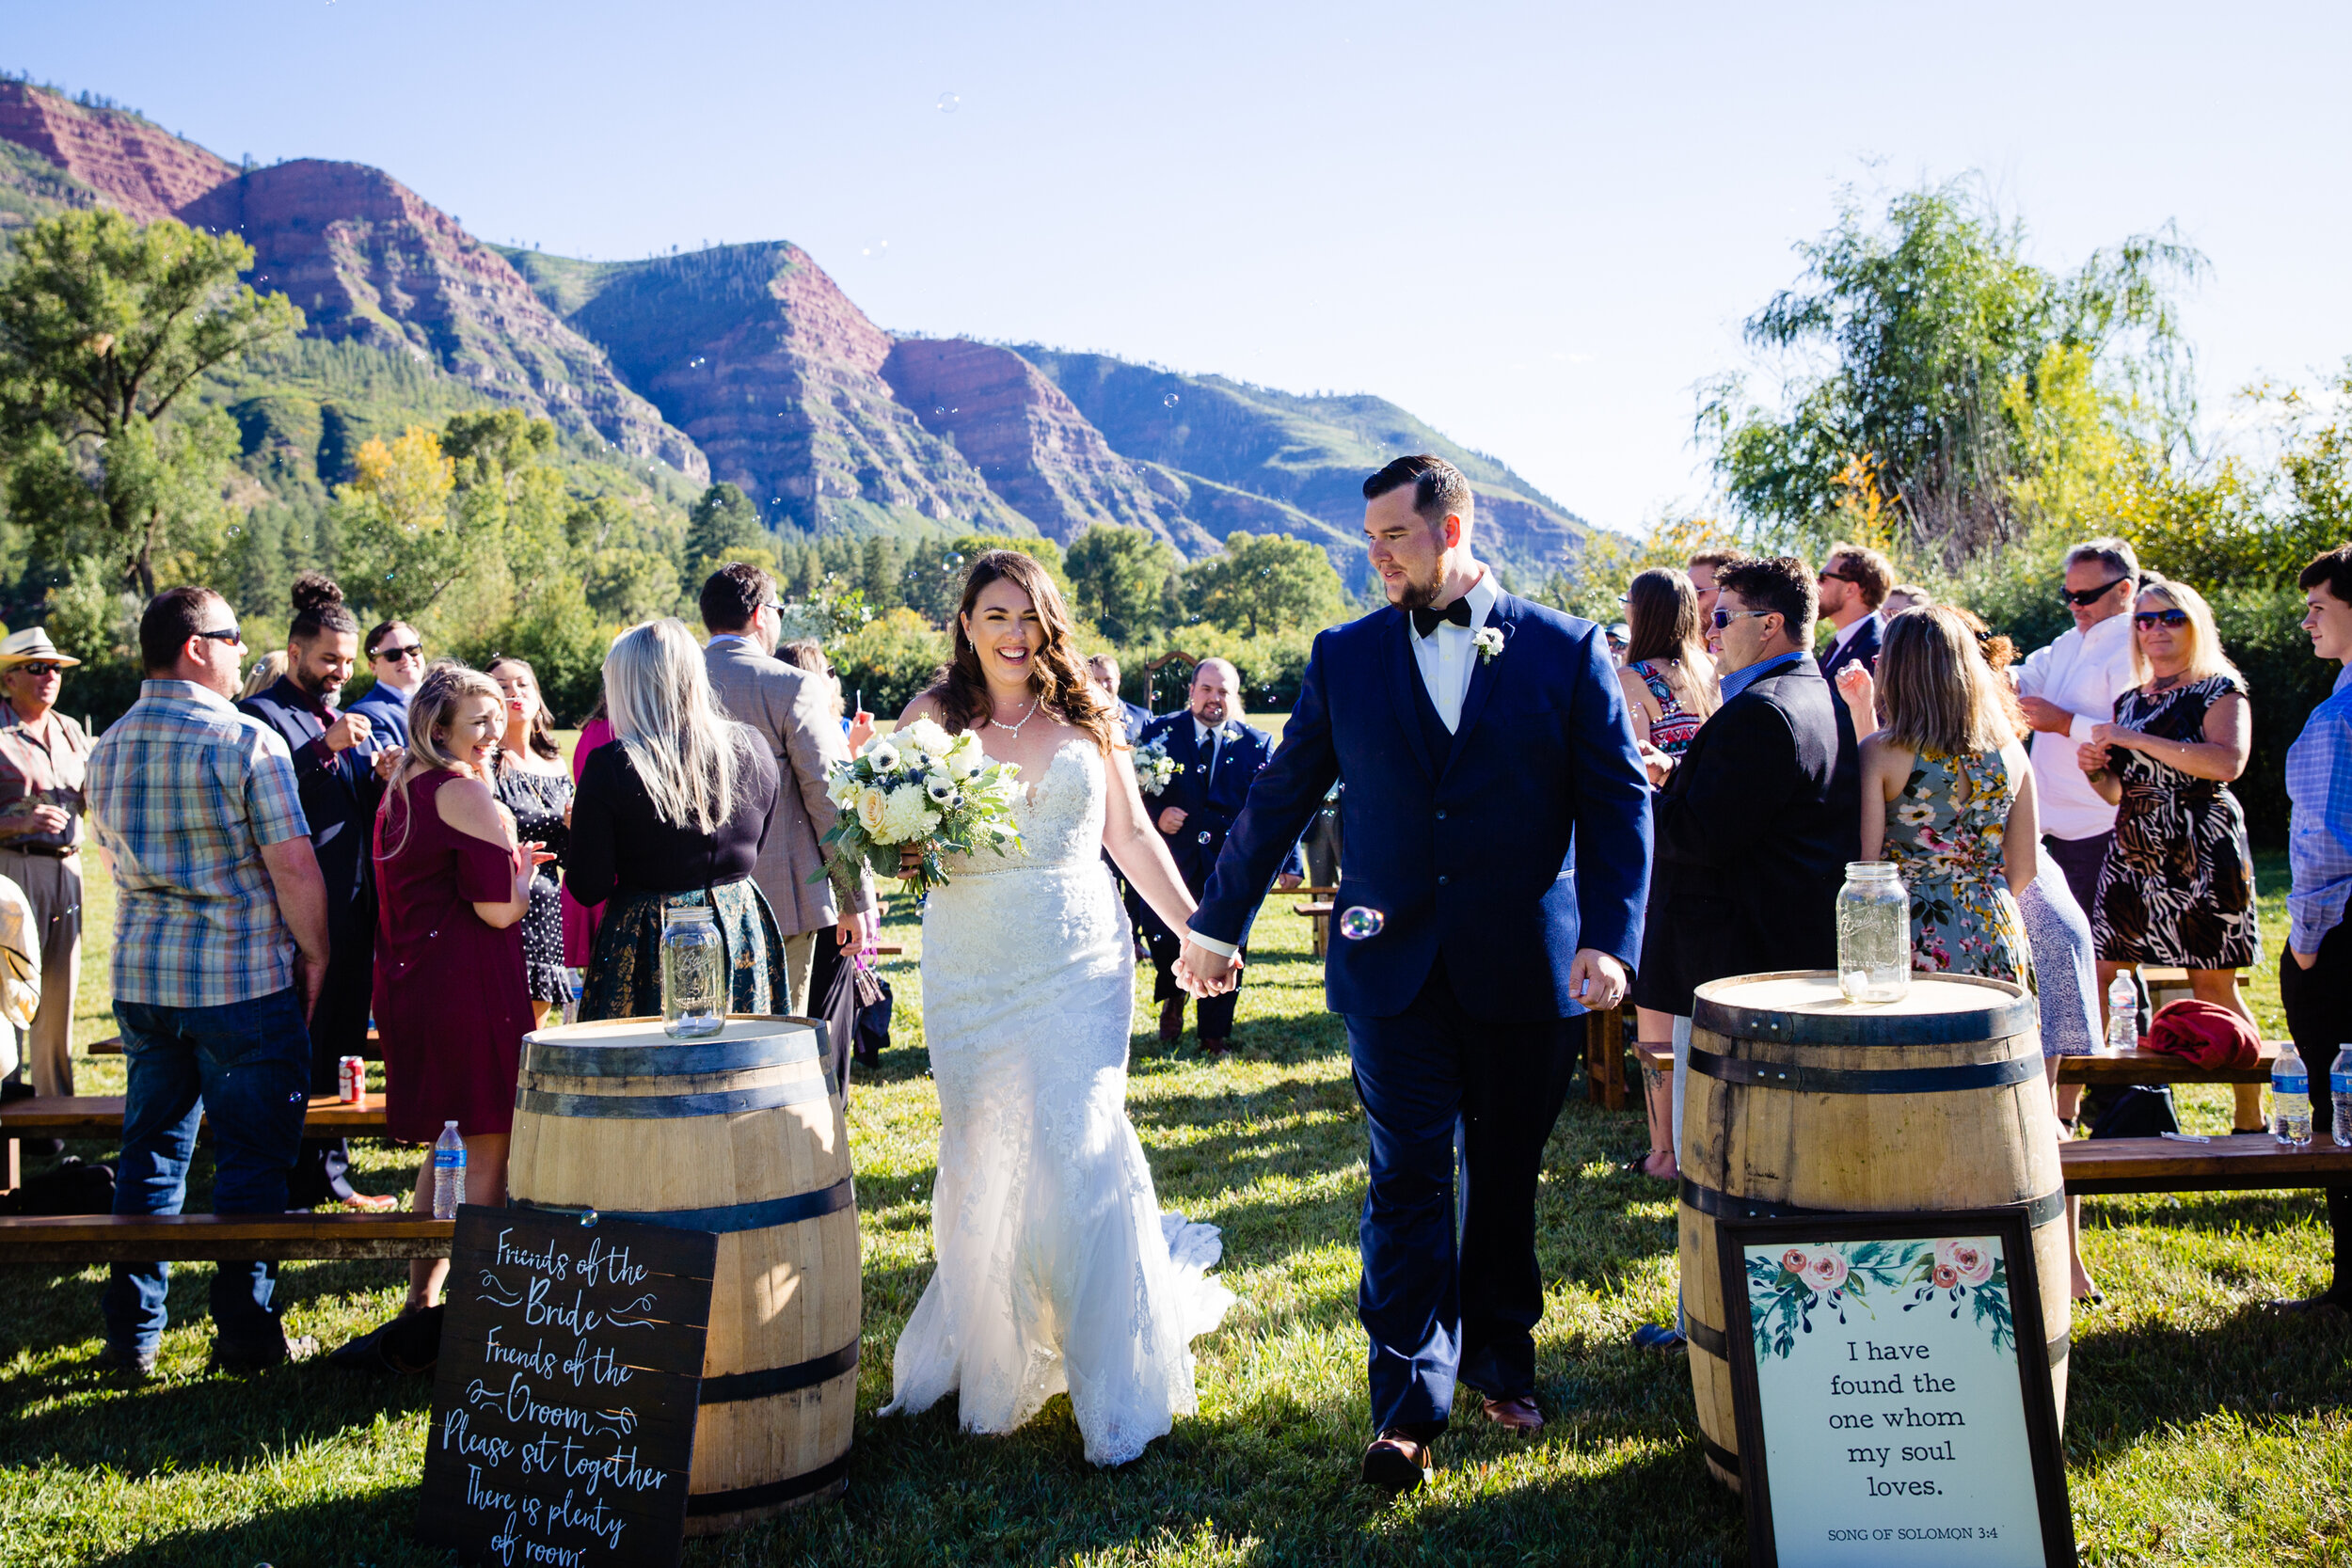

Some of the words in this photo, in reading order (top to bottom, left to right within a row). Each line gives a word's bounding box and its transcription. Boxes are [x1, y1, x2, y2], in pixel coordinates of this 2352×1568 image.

[496, 1227, 568, 1281] Friends
[576, 1237, 604, 1287] of
[609, 1245, 649, 1286] the
[526, 1275, 601, 1337] Bride
[485, 1325, 559, 1380] Friends
[564, 1338, 590, 1387] of
[594, 1347, 633, 1386] the
[1847, 1341, 1859, 1361] I
[1867, 1340, 1931, 1361] have
[507, 1371, 595, 1435] Groom
[1831, 1374, 1905, 1396] found
[1913, 1373, 1957, 1393] the
[1829, 1413, 1875, 1430] one
[1883, 1407, 1966, 1428] whom
[443, 1408, 515, 1467] Please
[521, 1431, 561, 1474] sit
[561, 1435, 668, 1496] together
[1848, 1448, 1892, 1467] my
[1901, 1441, 1957, 1462] soul
[467, 1463, 516, 1511] There
[522, 1495, 542, 1527] is
[547, 1488, 628, 1550] plenty
[1867, 1476, 1944, 1497] loves.
[491, 1511, 523, 1567] of
[1828, 1529, 1868, 1542] SONG
[1872, 1528, 1894, 1541] OF
[1898, 1528, 1974, 1541] SOLOMON
[1978, 1527, 1999, 1540] 3:4
